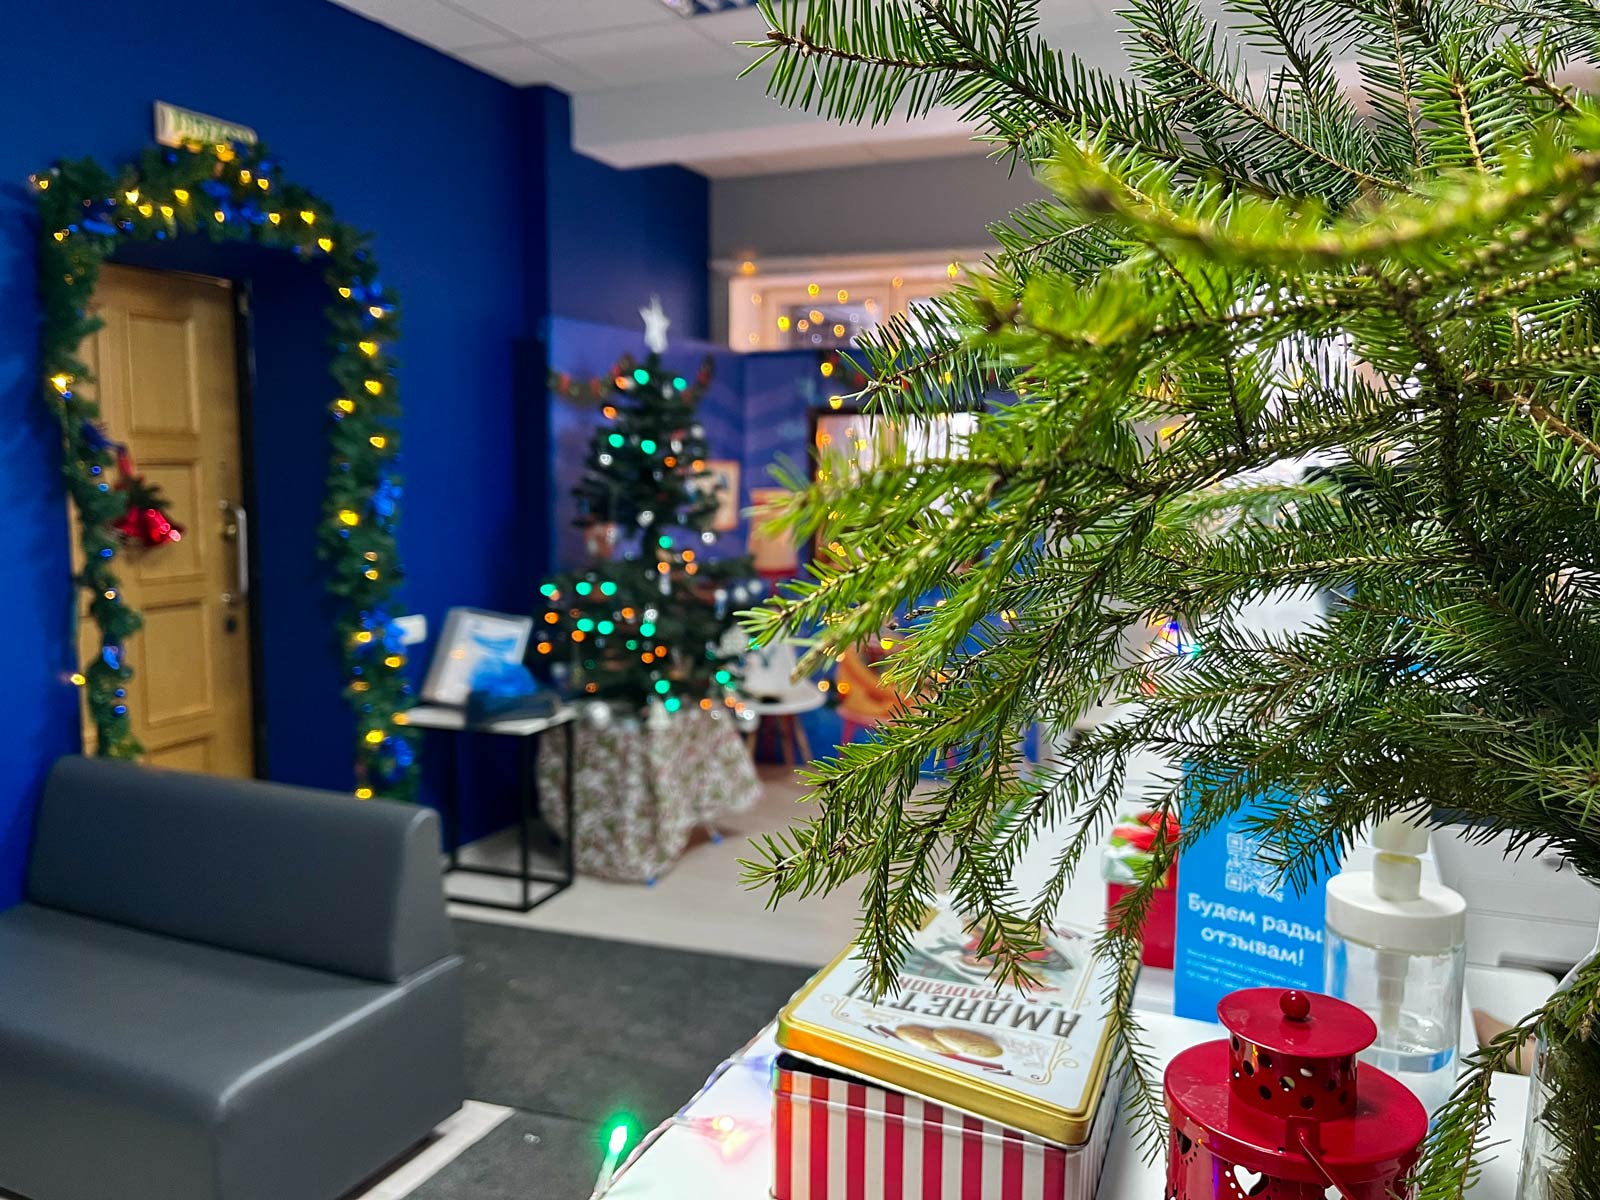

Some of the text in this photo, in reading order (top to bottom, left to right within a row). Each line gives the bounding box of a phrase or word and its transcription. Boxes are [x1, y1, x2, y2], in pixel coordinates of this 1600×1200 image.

[1187, 892, 1323, 944] Будем рады
[1200, 926, 1304, 967] отзывам!
